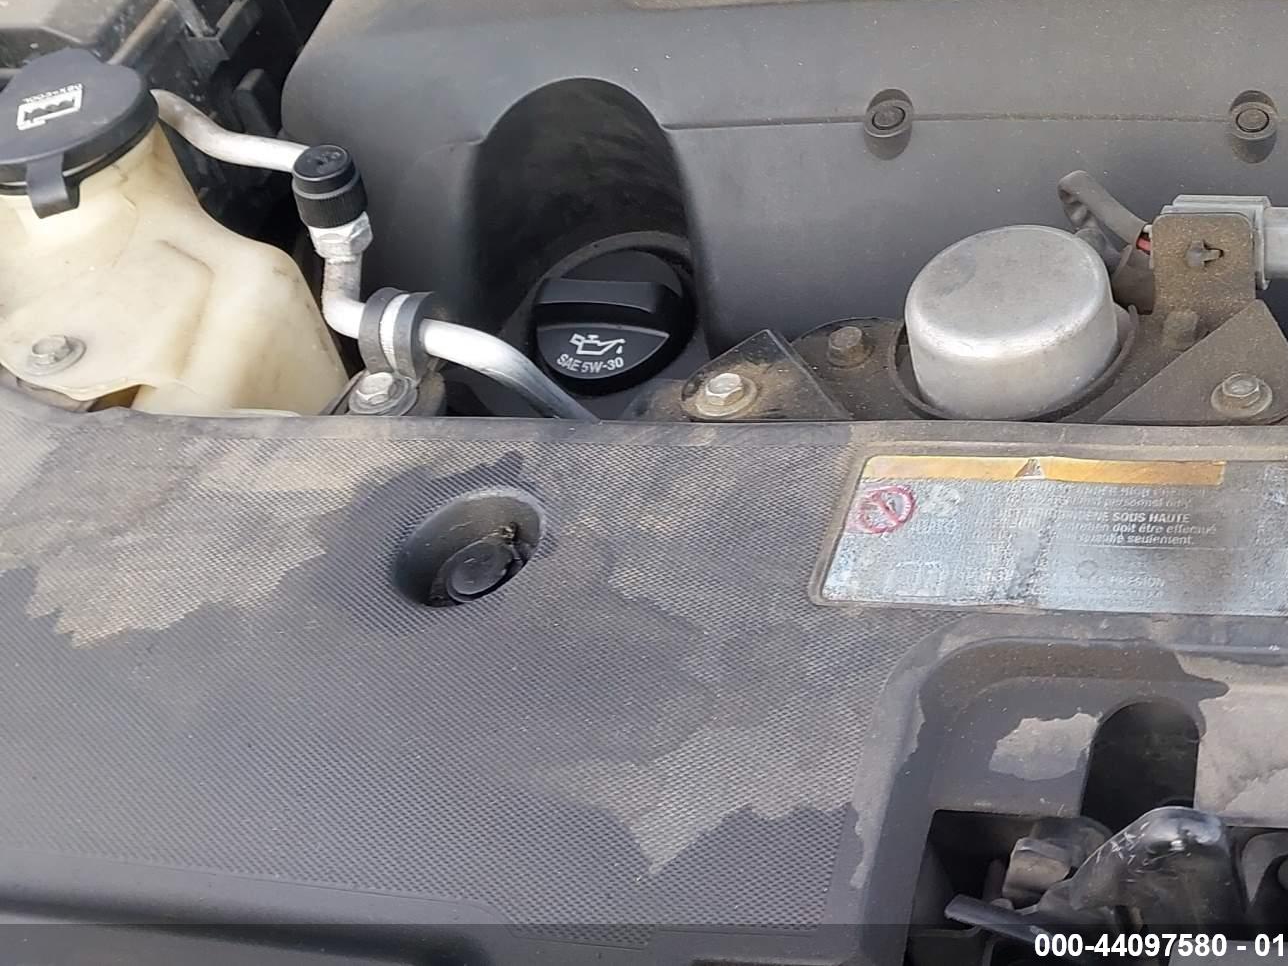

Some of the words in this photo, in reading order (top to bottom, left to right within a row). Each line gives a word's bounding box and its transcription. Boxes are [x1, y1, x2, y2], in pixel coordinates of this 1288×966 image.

[557, 354, 582, 372] SAE
[581, 357, 624, 373] 5W-30
[1112, 512, 1146, 523] SOUS
[1148, 512, 1191, 524] HAUTE
[1112, 522, 1136, 534] doit
[1138, 522, 1164, 534] être
